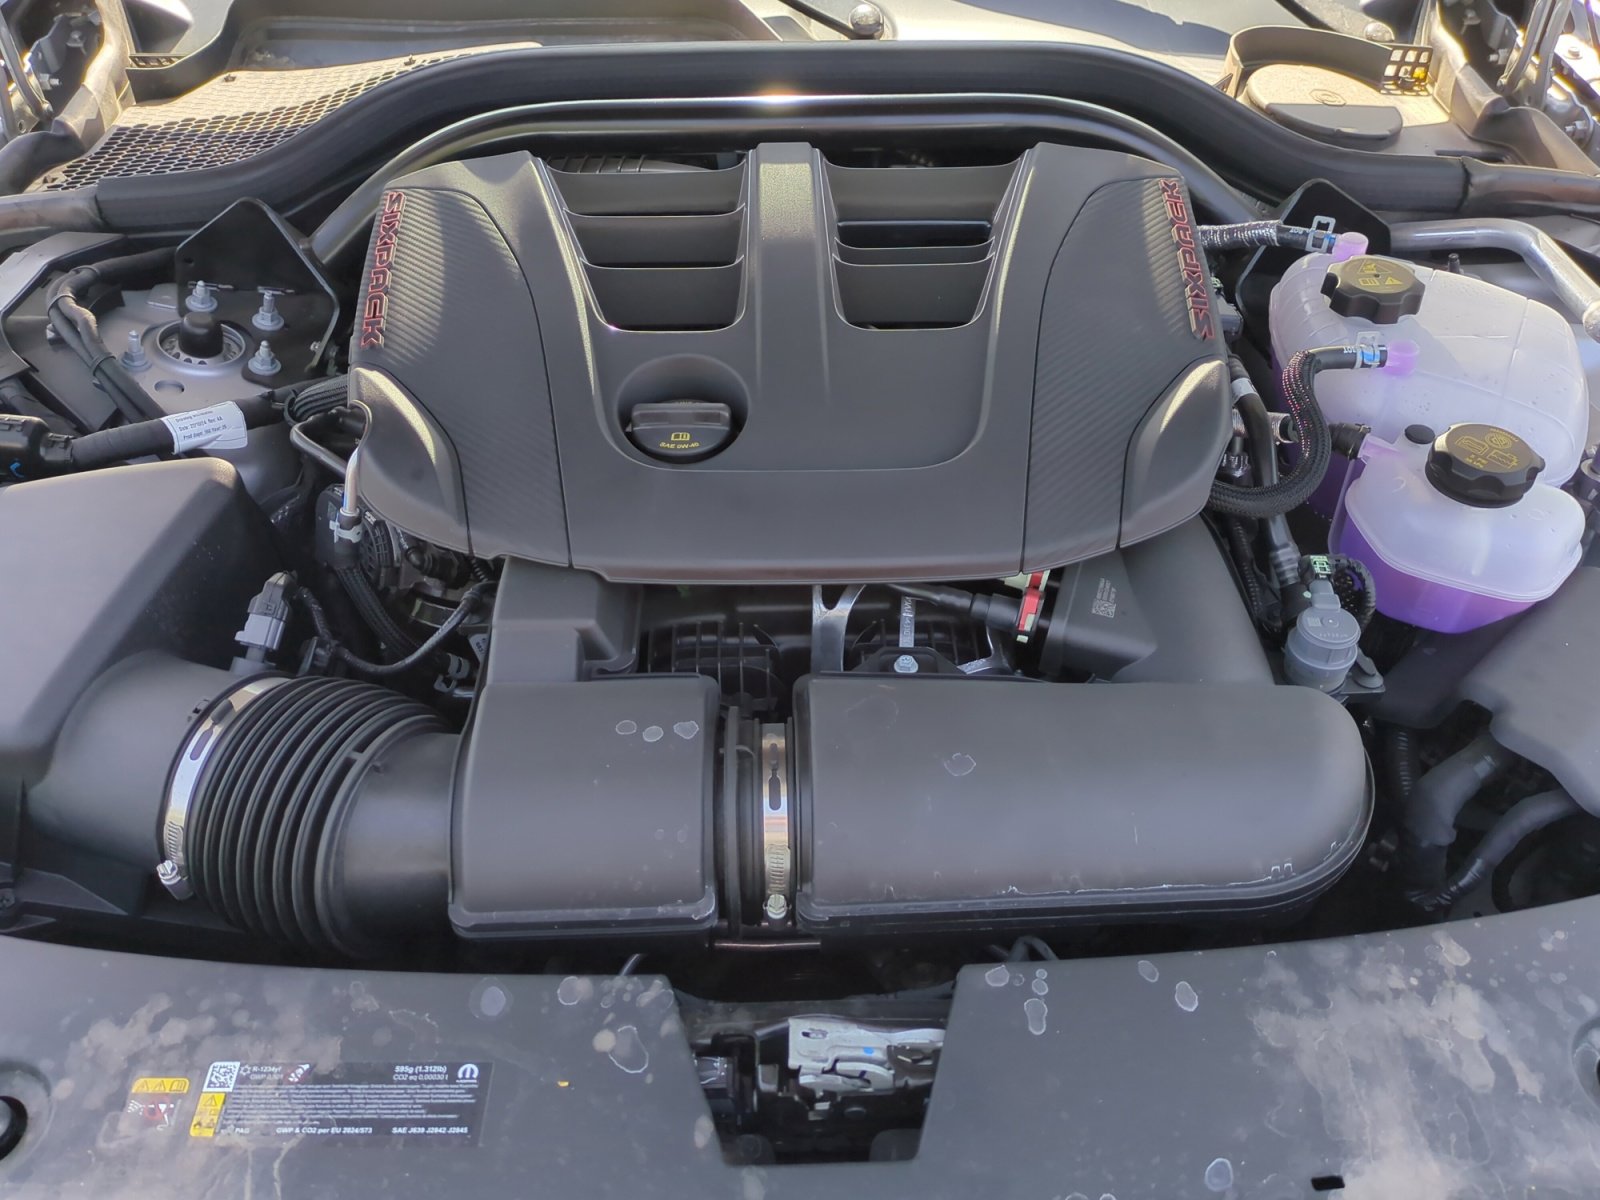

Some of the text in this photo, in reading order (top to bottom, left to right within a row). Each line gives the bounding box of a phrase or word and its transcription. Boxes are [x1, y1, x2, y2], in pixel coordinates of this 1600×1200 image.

[361, 192, 405, 348] SIXPACK
[1159, 179, 1216, 340] SIXPACK
[394, 1066, 414, 1074] 595g
